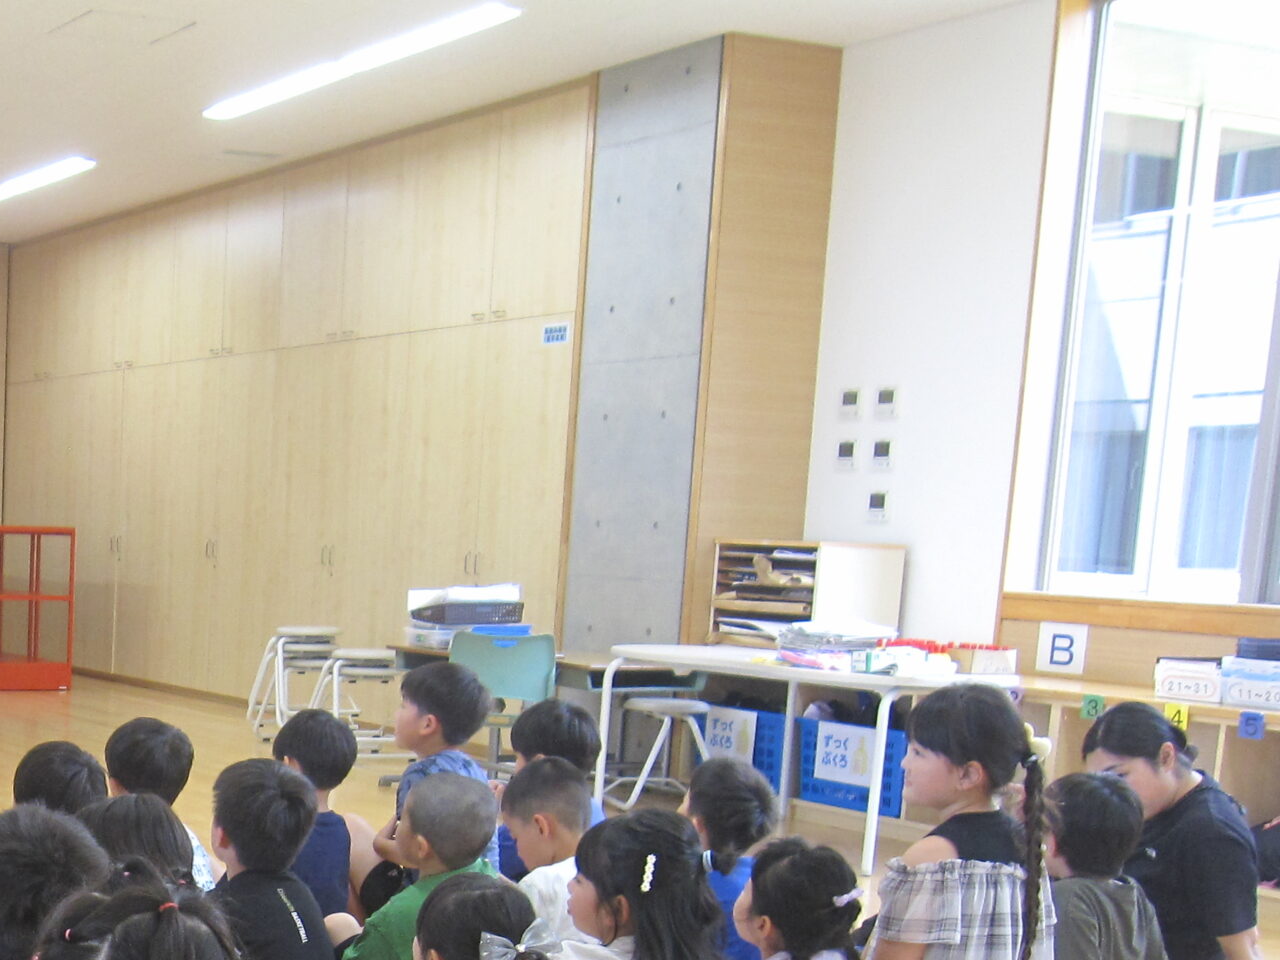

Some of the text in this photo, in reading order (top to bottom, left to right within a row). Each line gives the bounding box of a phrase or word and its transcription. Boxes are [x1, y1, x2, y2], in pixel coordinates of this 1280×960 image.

[1049, 633, 1075, 666] B
[1086, 698, 1099, 717] 3
[1170, 709, 1184, 726] 4
[1244, 716, 1259, 736] 5
[821, 751, 848, 769] ぶくろ
